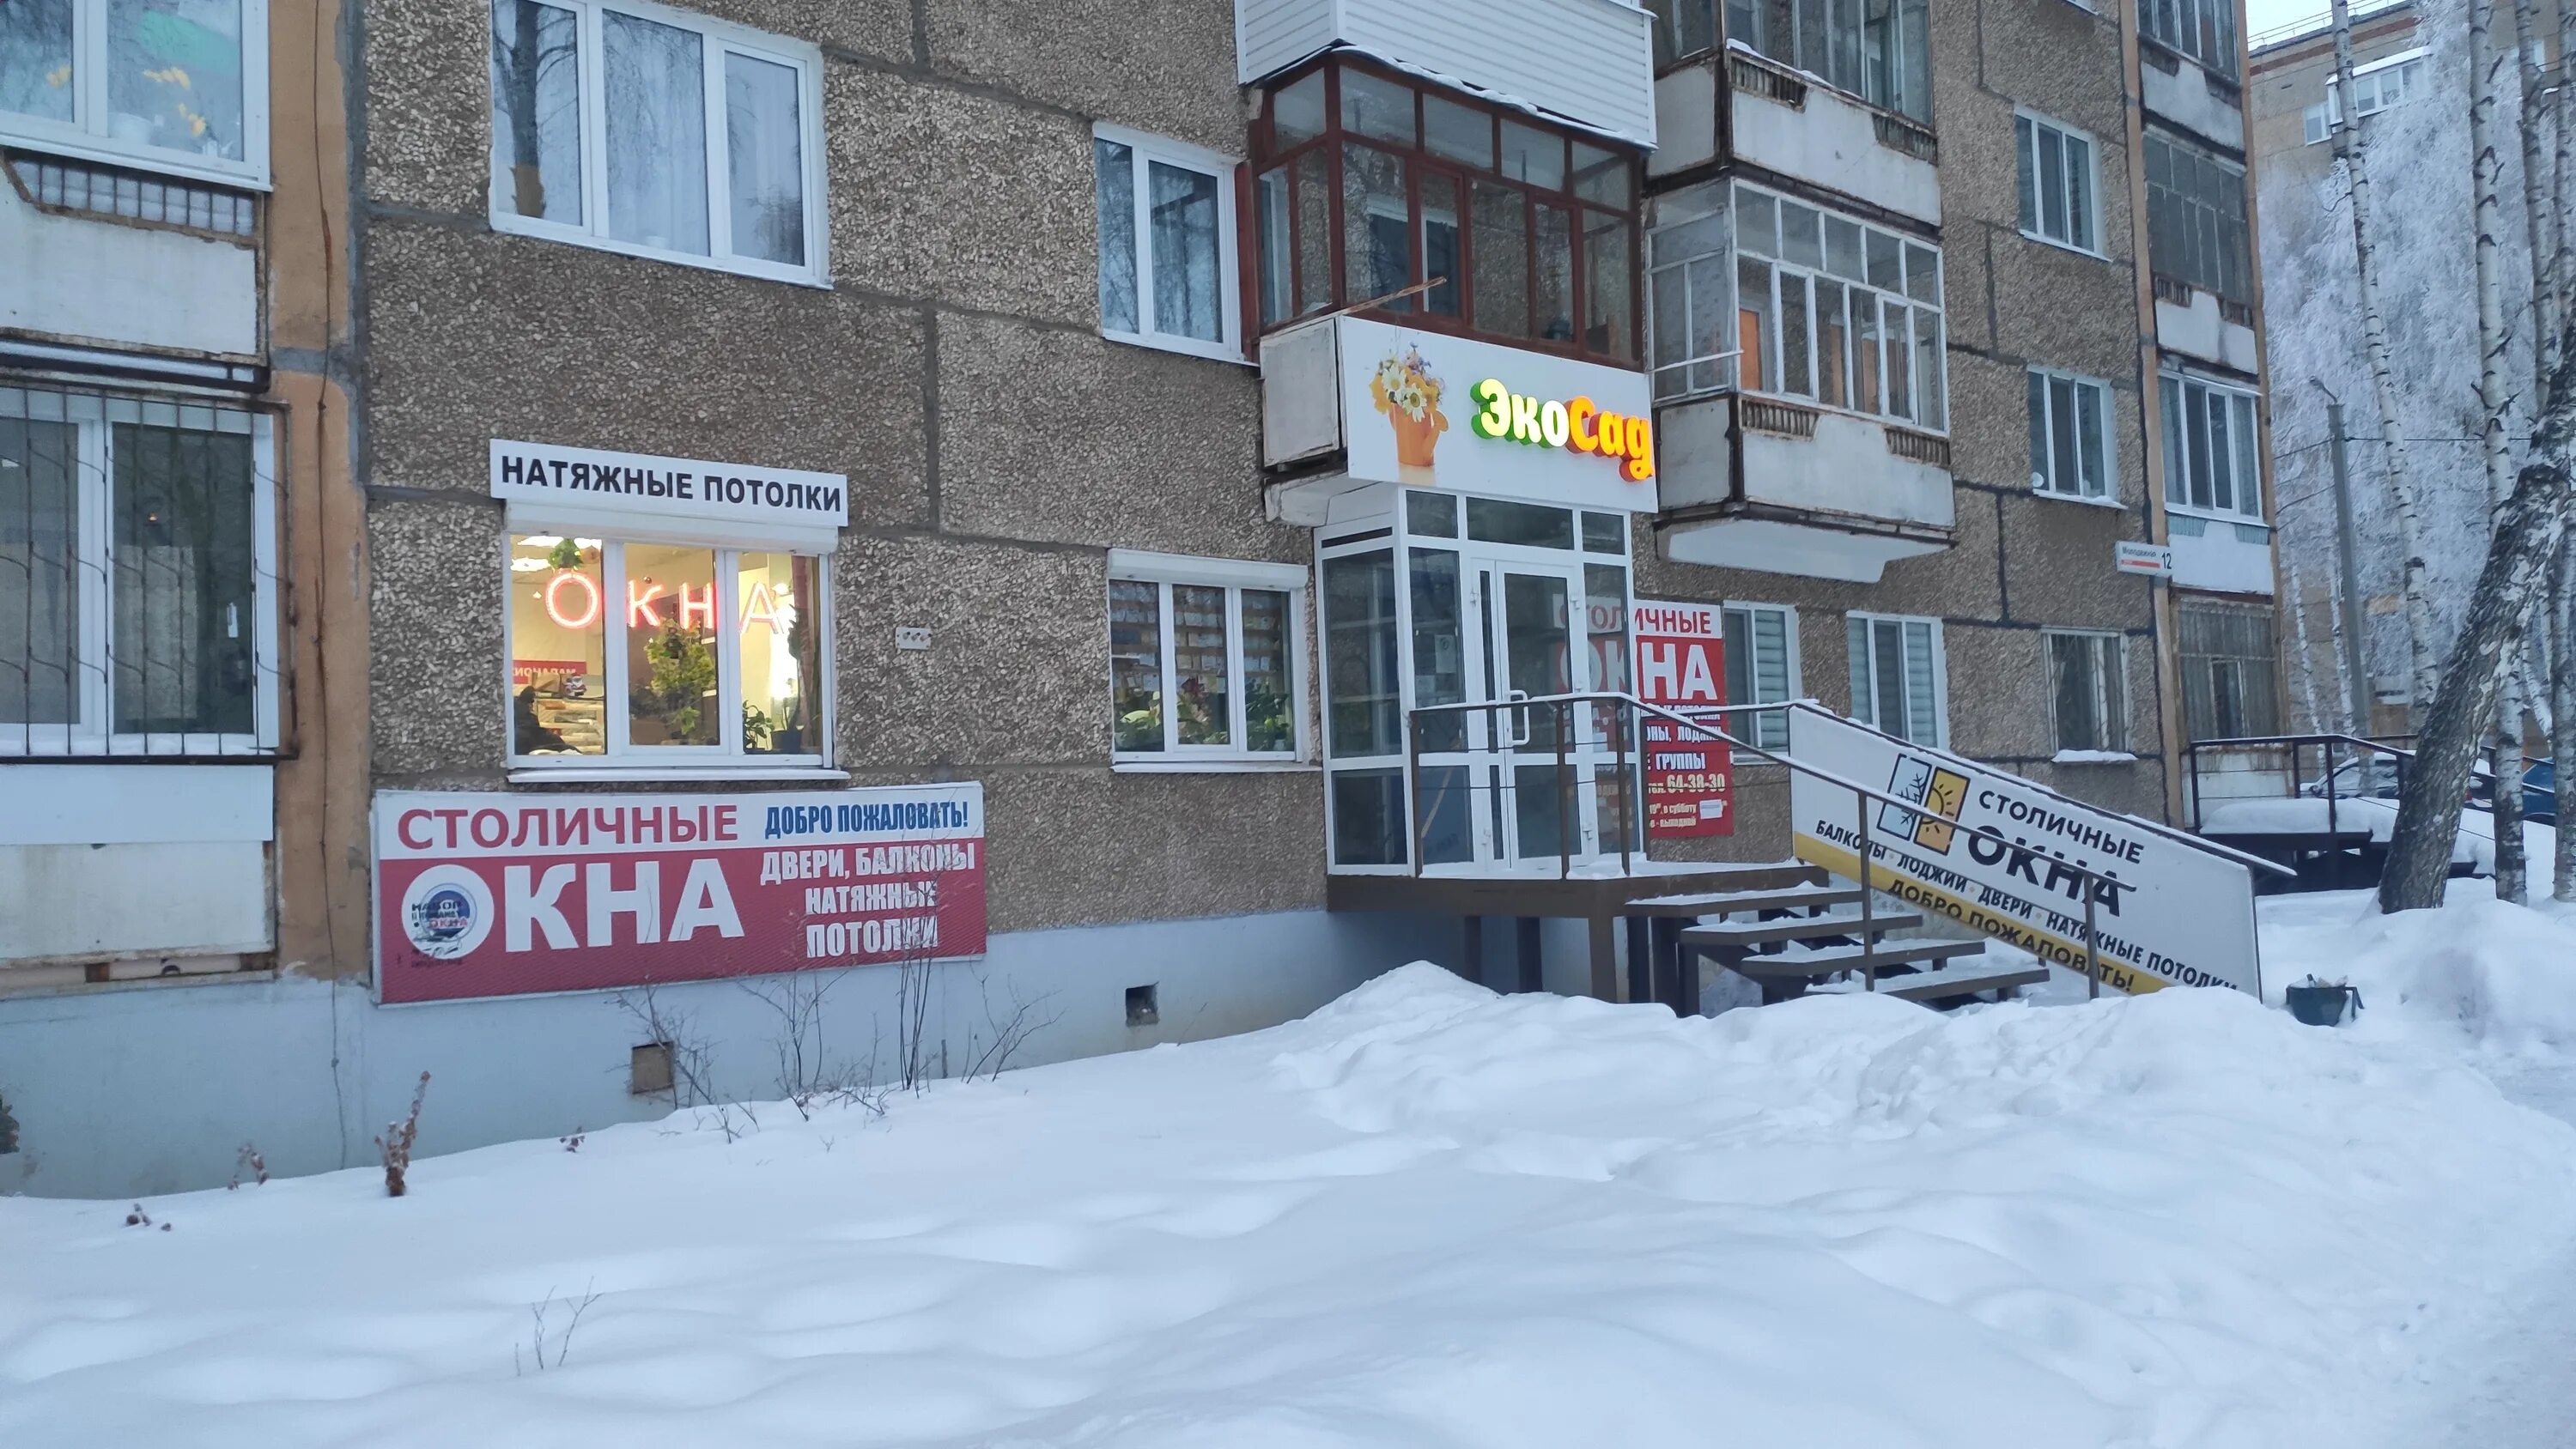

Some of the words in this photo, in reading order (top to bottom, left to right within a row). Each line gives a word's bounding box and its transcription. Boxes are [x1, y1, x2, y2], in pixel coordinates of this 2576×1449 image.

[501, 455, 694, 500] НАТЯЖНЫЕ
[704, 475, 841, 512] ПОТОЛКИ
[2161, 552, 2172, 570] 12
[545, 570, 784, 634] ОКНА
[1655, 752, 1706, 771] ГРУППЫ
[1667, 773, 1726, 794] 64-38-30
[398, 804, 738, 851] СТОЛИЧНЫЕ
[764, 804, 833, 840] ДОБРО
[837, 801, 969, 833] ПОЖАЛОВАТЬ!
[1978, 790, 2145, 864] СТОЛИЧНЫЕ
[760, 848, 850, 886] ДВЕРИ,
[855, 842, 975, 876] БАЛКОНЫ
[1968, 825, 2121, 918] ОКНА
[401, 858, 745, 960] ОКНА
[805, 880, 939, 915] НАТЯЖНЫЕ
[805, 915, 939, 959] ПОТОЛКИ
[1887, 879, 1963, 920] ДОБРО
[1968, 911, 2136, 992] ПОЖАЛОВТЬ!
[1897, 853, 1968, 894] ЛОДЖИИ
[1977, 885, 2032, 920] ДВЕРИ
[2147, 952, 2239, 991] ПОТОЛК
